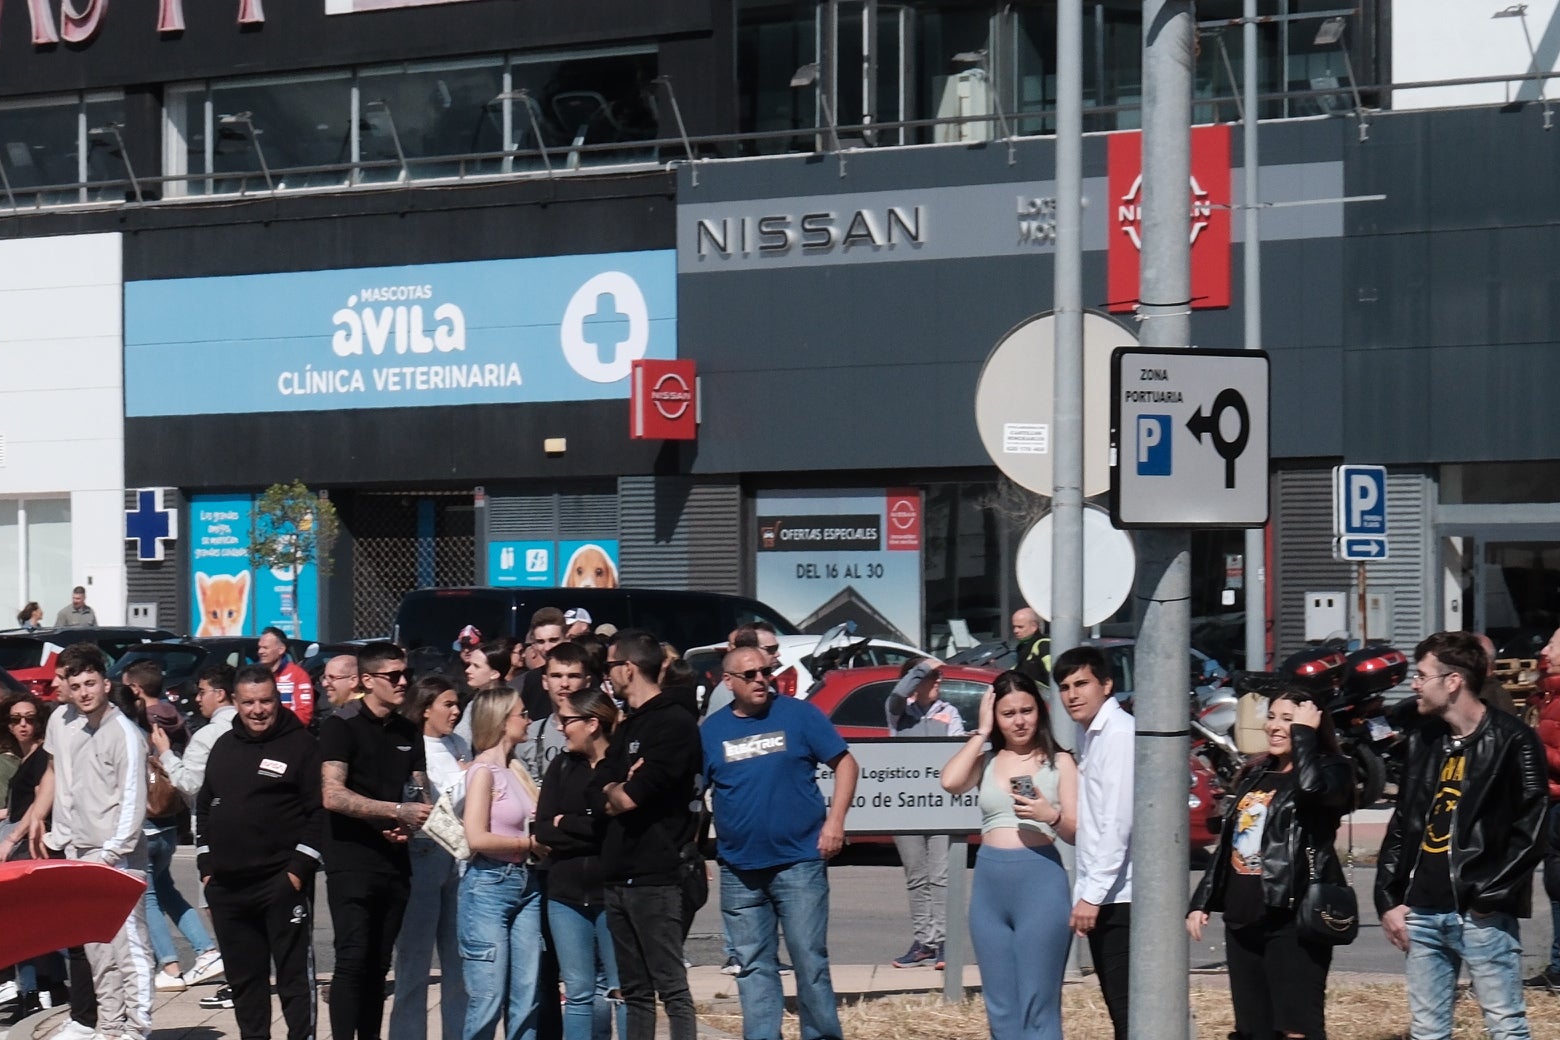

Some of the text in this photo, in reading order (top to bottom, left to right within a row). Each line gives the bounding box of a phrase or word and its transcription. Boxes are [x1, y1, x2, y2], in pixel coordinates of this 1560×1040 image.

[696, 206, 925, 258] NISSAN
[360, 284, 433, 303] MASCOTAS
[277, 361, 523, 396] CLÍNICA VETERINARIA
[1140, 369, 1169, 381] ZONA
[651, 390, 691, 400] NISSAN
[1125, 390, 1184, 403] PORTUARIA
[1138, 418, 1162, 463] P
[1350, 474, 1379, 528] P
[780, 528, 822, 541] OFERTAS
[823, 527, 878, 541] ESPECIALES
[796, 563, 884, 579] DEL 16 AL 30
[726, 736, 785, 758] ELECTRIC
[872, 791, 893, 808] de
[897, 791, 944, 808] Santa
